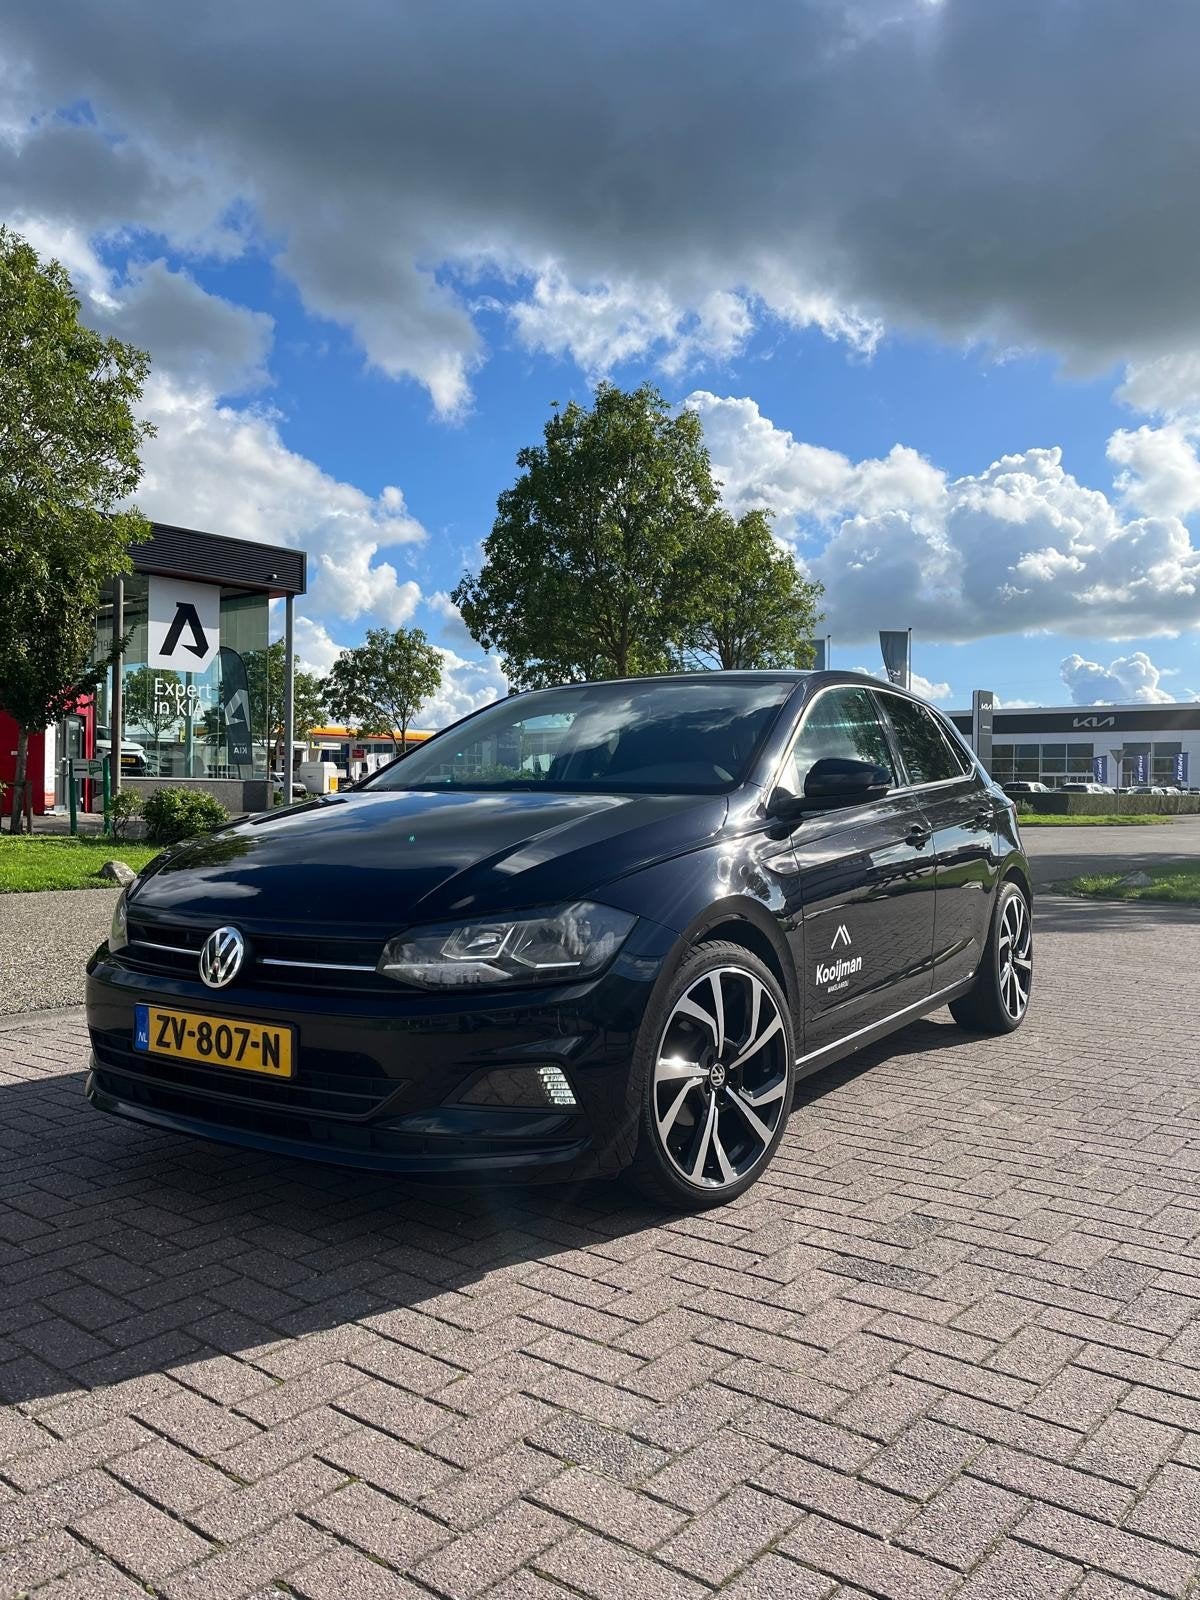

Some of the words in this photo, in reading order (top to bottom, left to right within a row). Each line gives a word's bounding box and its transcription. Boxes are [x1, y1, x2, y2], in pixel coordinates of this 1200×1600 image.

[154, 678, 212, 702] Expert
[154, 697, 170, 715] in
[176, 699, 205, 717] KIA
[1072, 716, 1115, 728] KIA
[815, 956, 862, 986] Kooijman
[138, 1031, 148, 1043] NL
[156, 1014, 280, 1069] ZV-807-N
